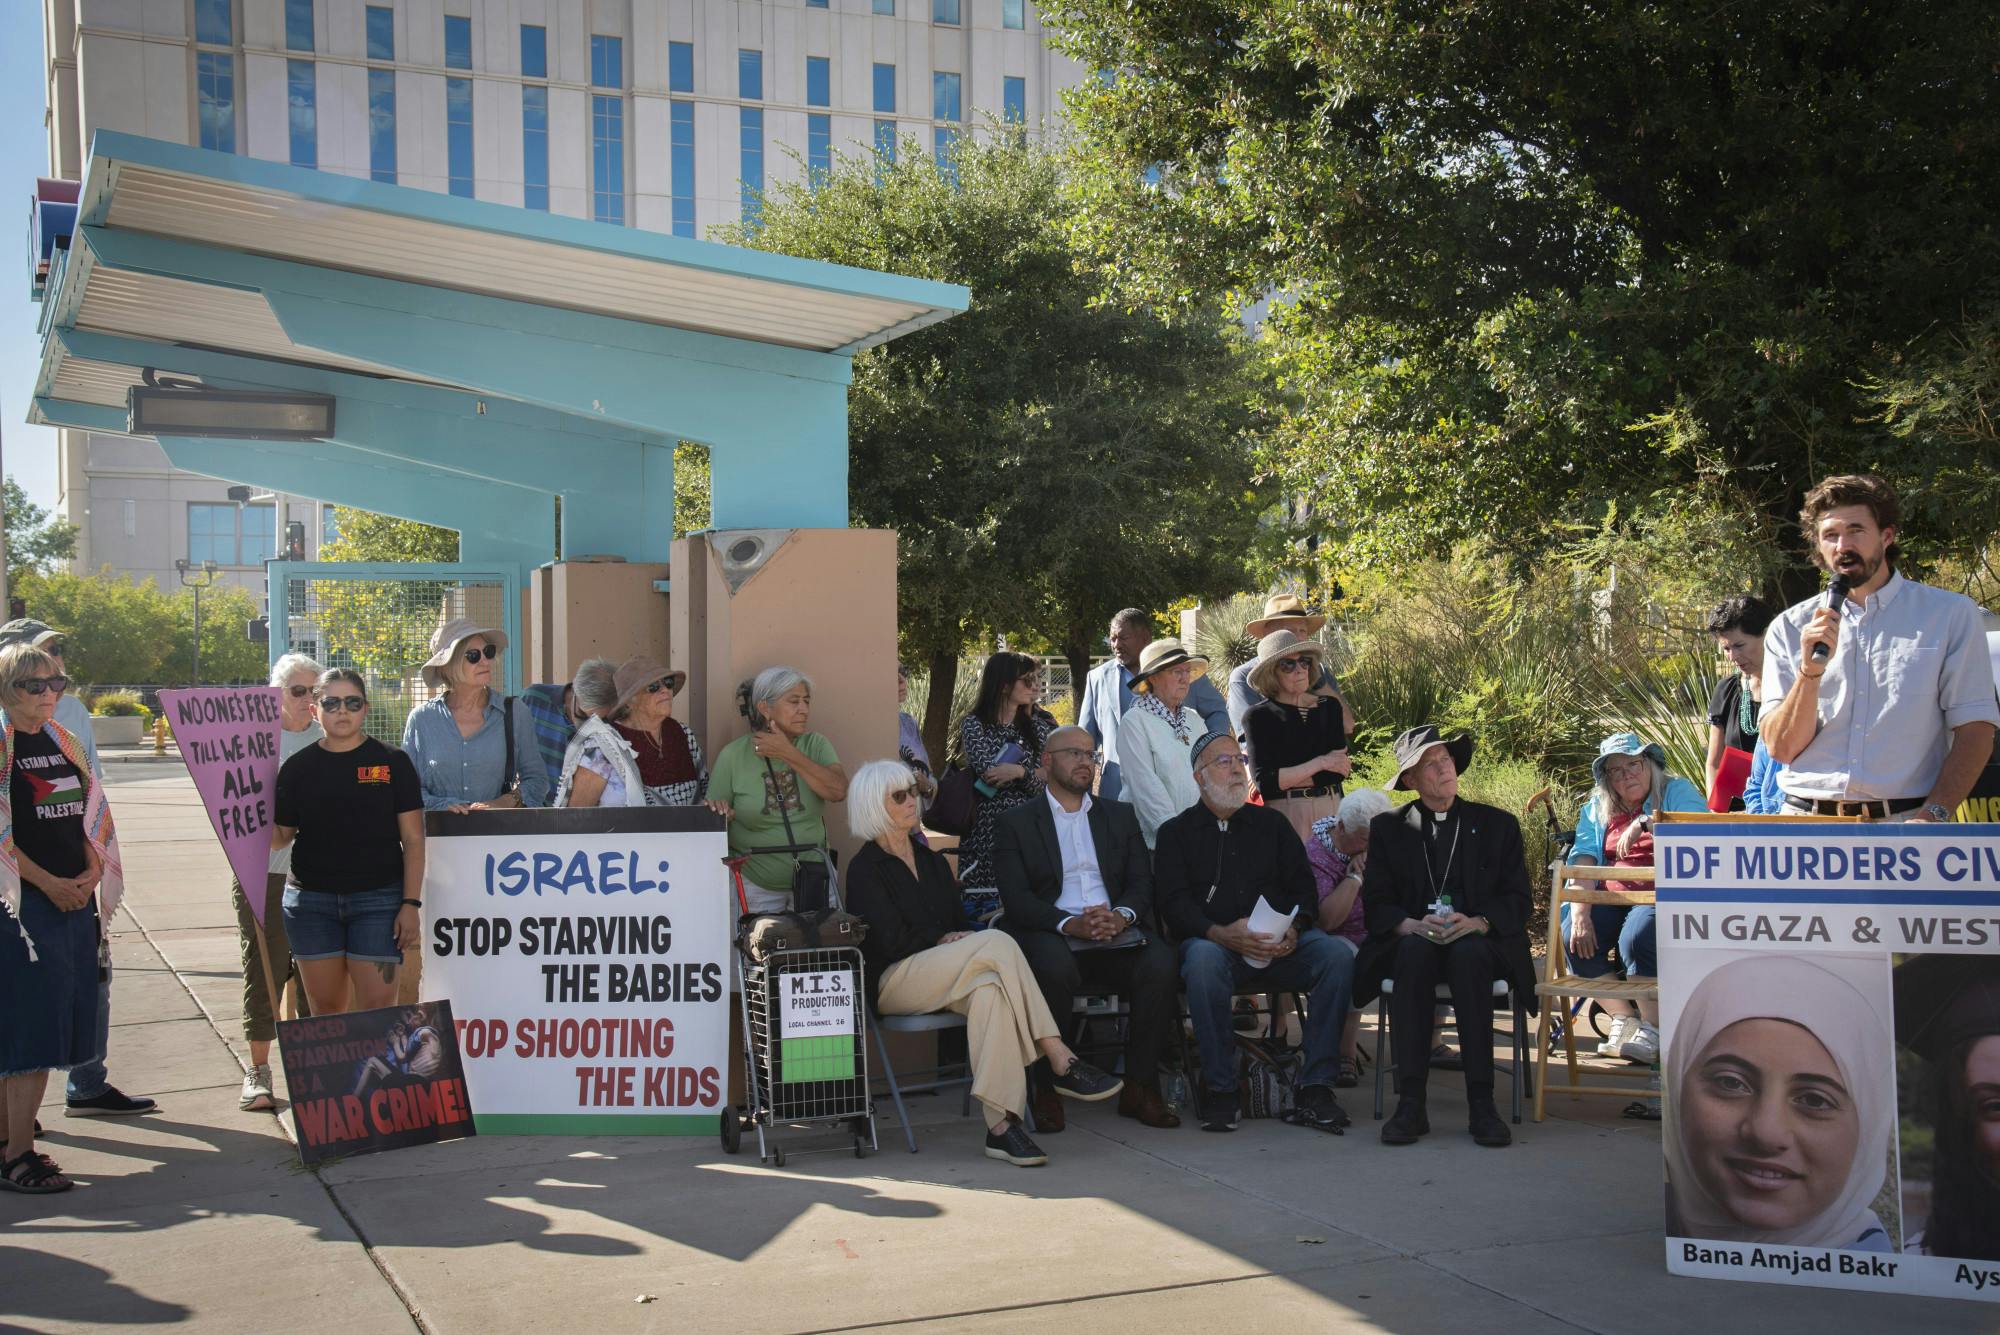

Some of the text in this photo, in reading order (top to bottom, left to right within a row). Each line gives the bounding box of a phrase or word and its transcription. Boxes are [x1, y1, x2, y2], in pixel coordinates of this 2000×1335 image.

[245, 694, 280, 722] FREE
[22, 756, 49, 769] STAND
[190, 731, 276, 765] TILL WE ARE
[223, 765, 263, 800] ALL
[36, 801, 84, 819] PALESTINE
[219, 800, 268, 841] FREE
[485, 850, 670, 896] ISRAEL:
[1664, 846, 1720, 880] IDF
[1735, 846, 1921, 881] MURDERS
[433, 915, 671, 957] STOP STARVING
[1672, 914, 1709, 940] IN
[1721, 914, 1832, 942] GAZA
[1852, 916, 1881, 943] &
[541, 962, 722, 1003] THE BABIES
[791, 975, 846, 995] M.I.S.
[791, 995, 850, 1009] PRODUCTIONS
[280, 1019, 347, 1044] FORCED
[454, 1018, 674, 1058] TOP SHOOTING
[286, 1038, 388, 1069] STARVATION
[291, 1073, 326, 1096] IS A
[575, 1066, 720, 1107] THE KIDS
[295, 1077, 468, 1147] WAR CRIME!
[1683, 1243, 2000, 1290] Bana Amjad Bakr Ays
